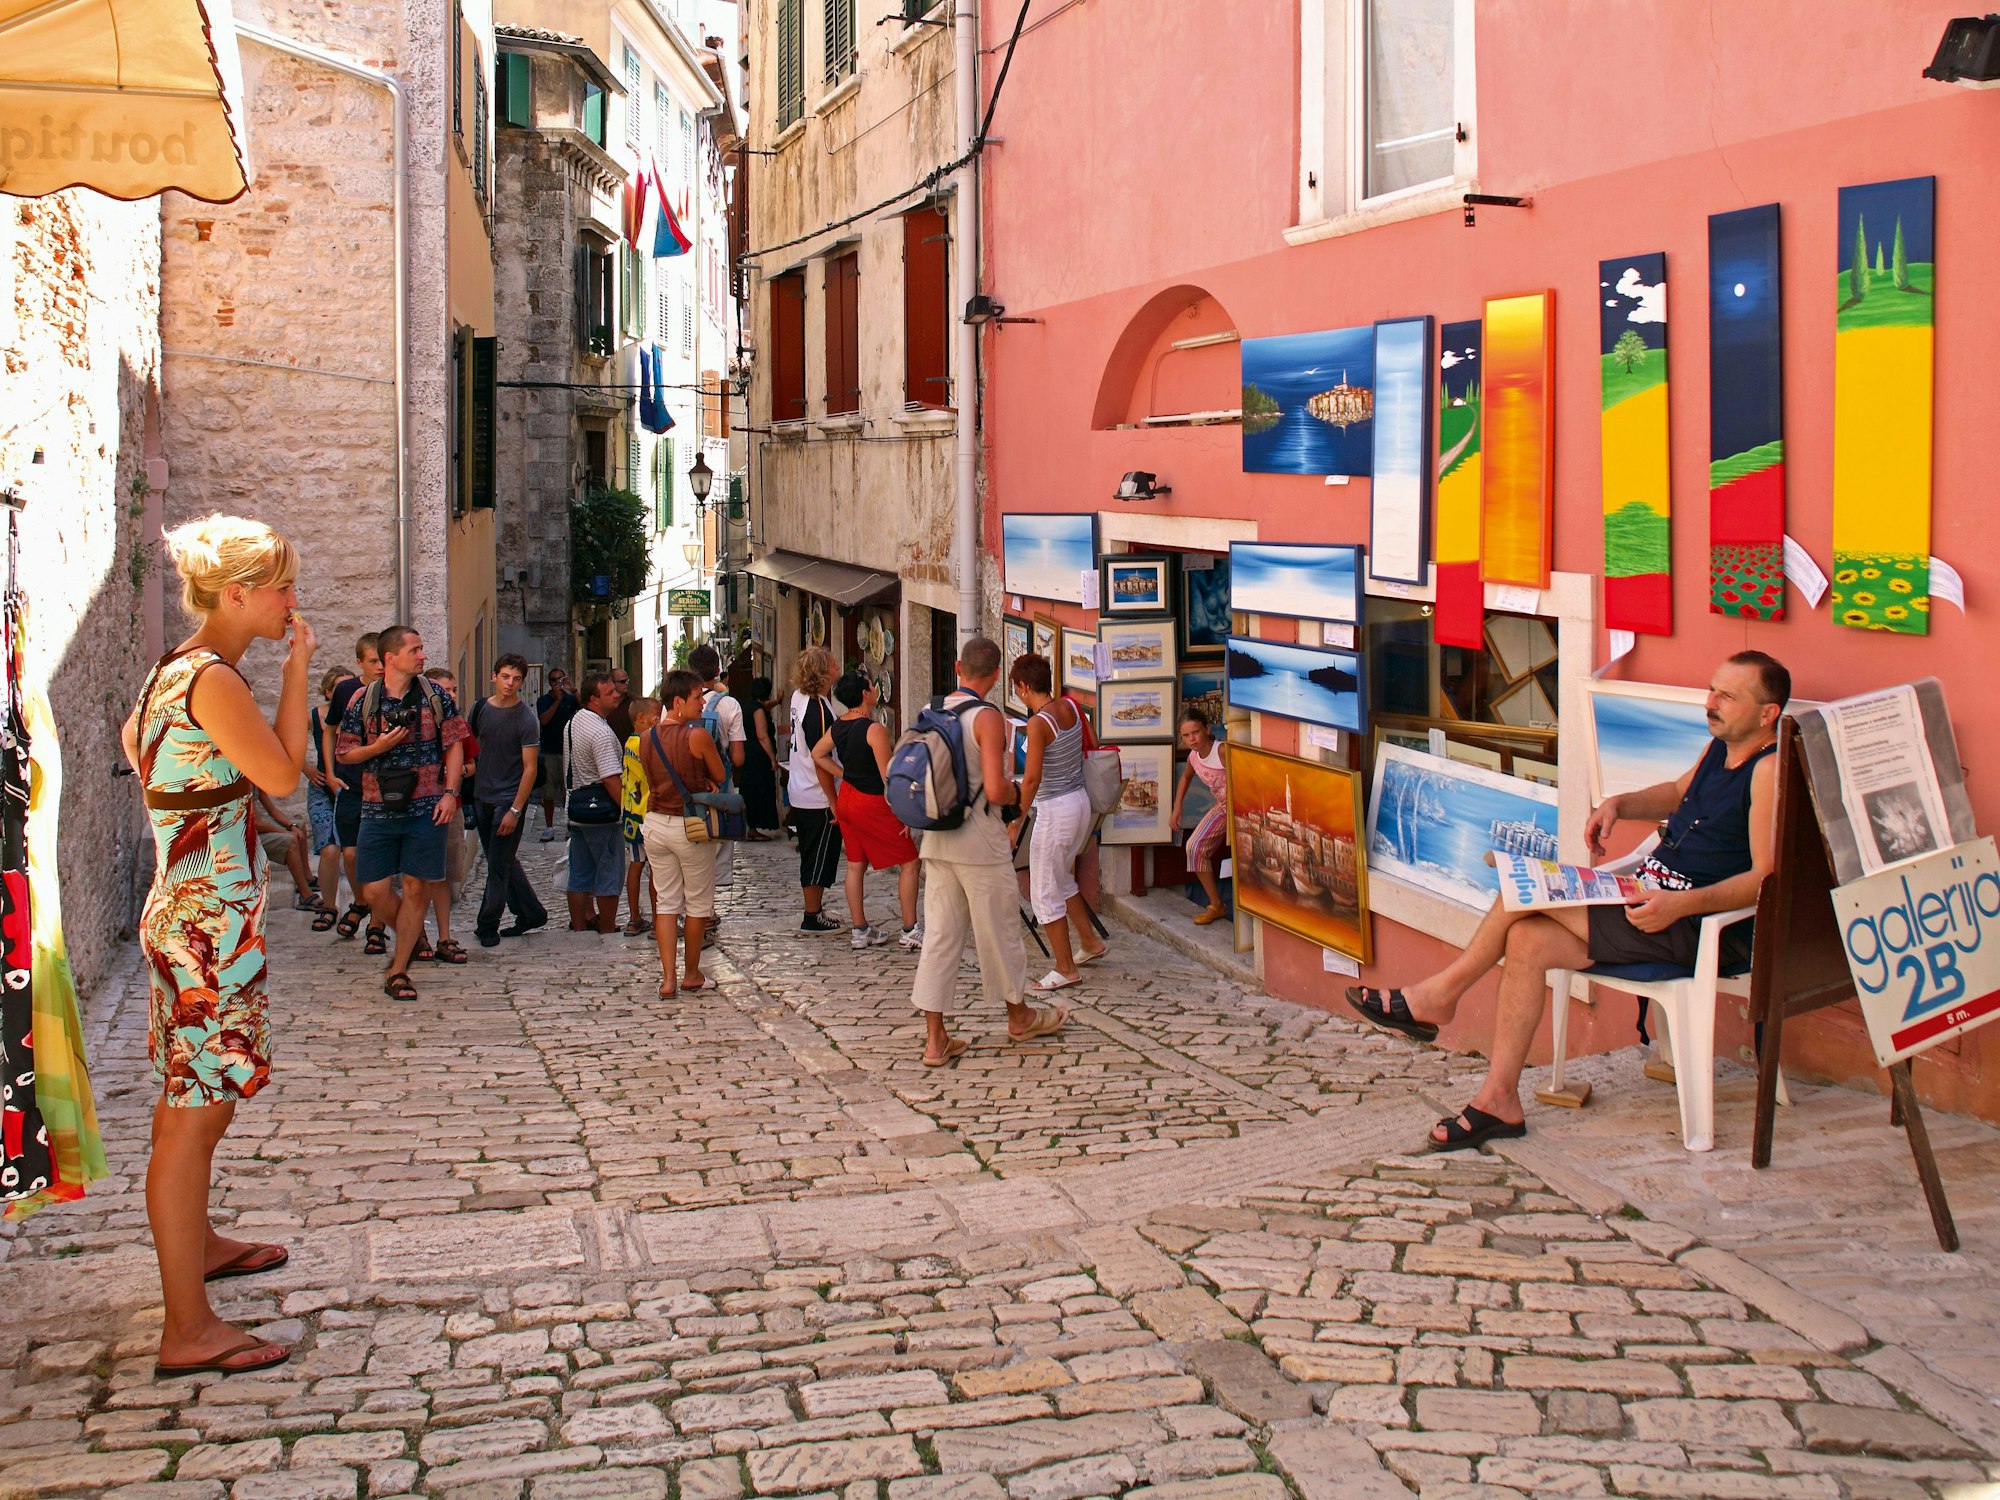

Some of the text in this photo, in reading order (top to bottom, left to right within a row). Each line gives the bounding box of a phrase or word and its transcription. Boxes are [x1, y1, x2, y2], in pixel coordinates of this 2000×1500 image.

[678, 597, 701, 605] SERGIO
[1847, 856, 2000, 994] galerija
[1946, 1012, 1955, 1025] 5
